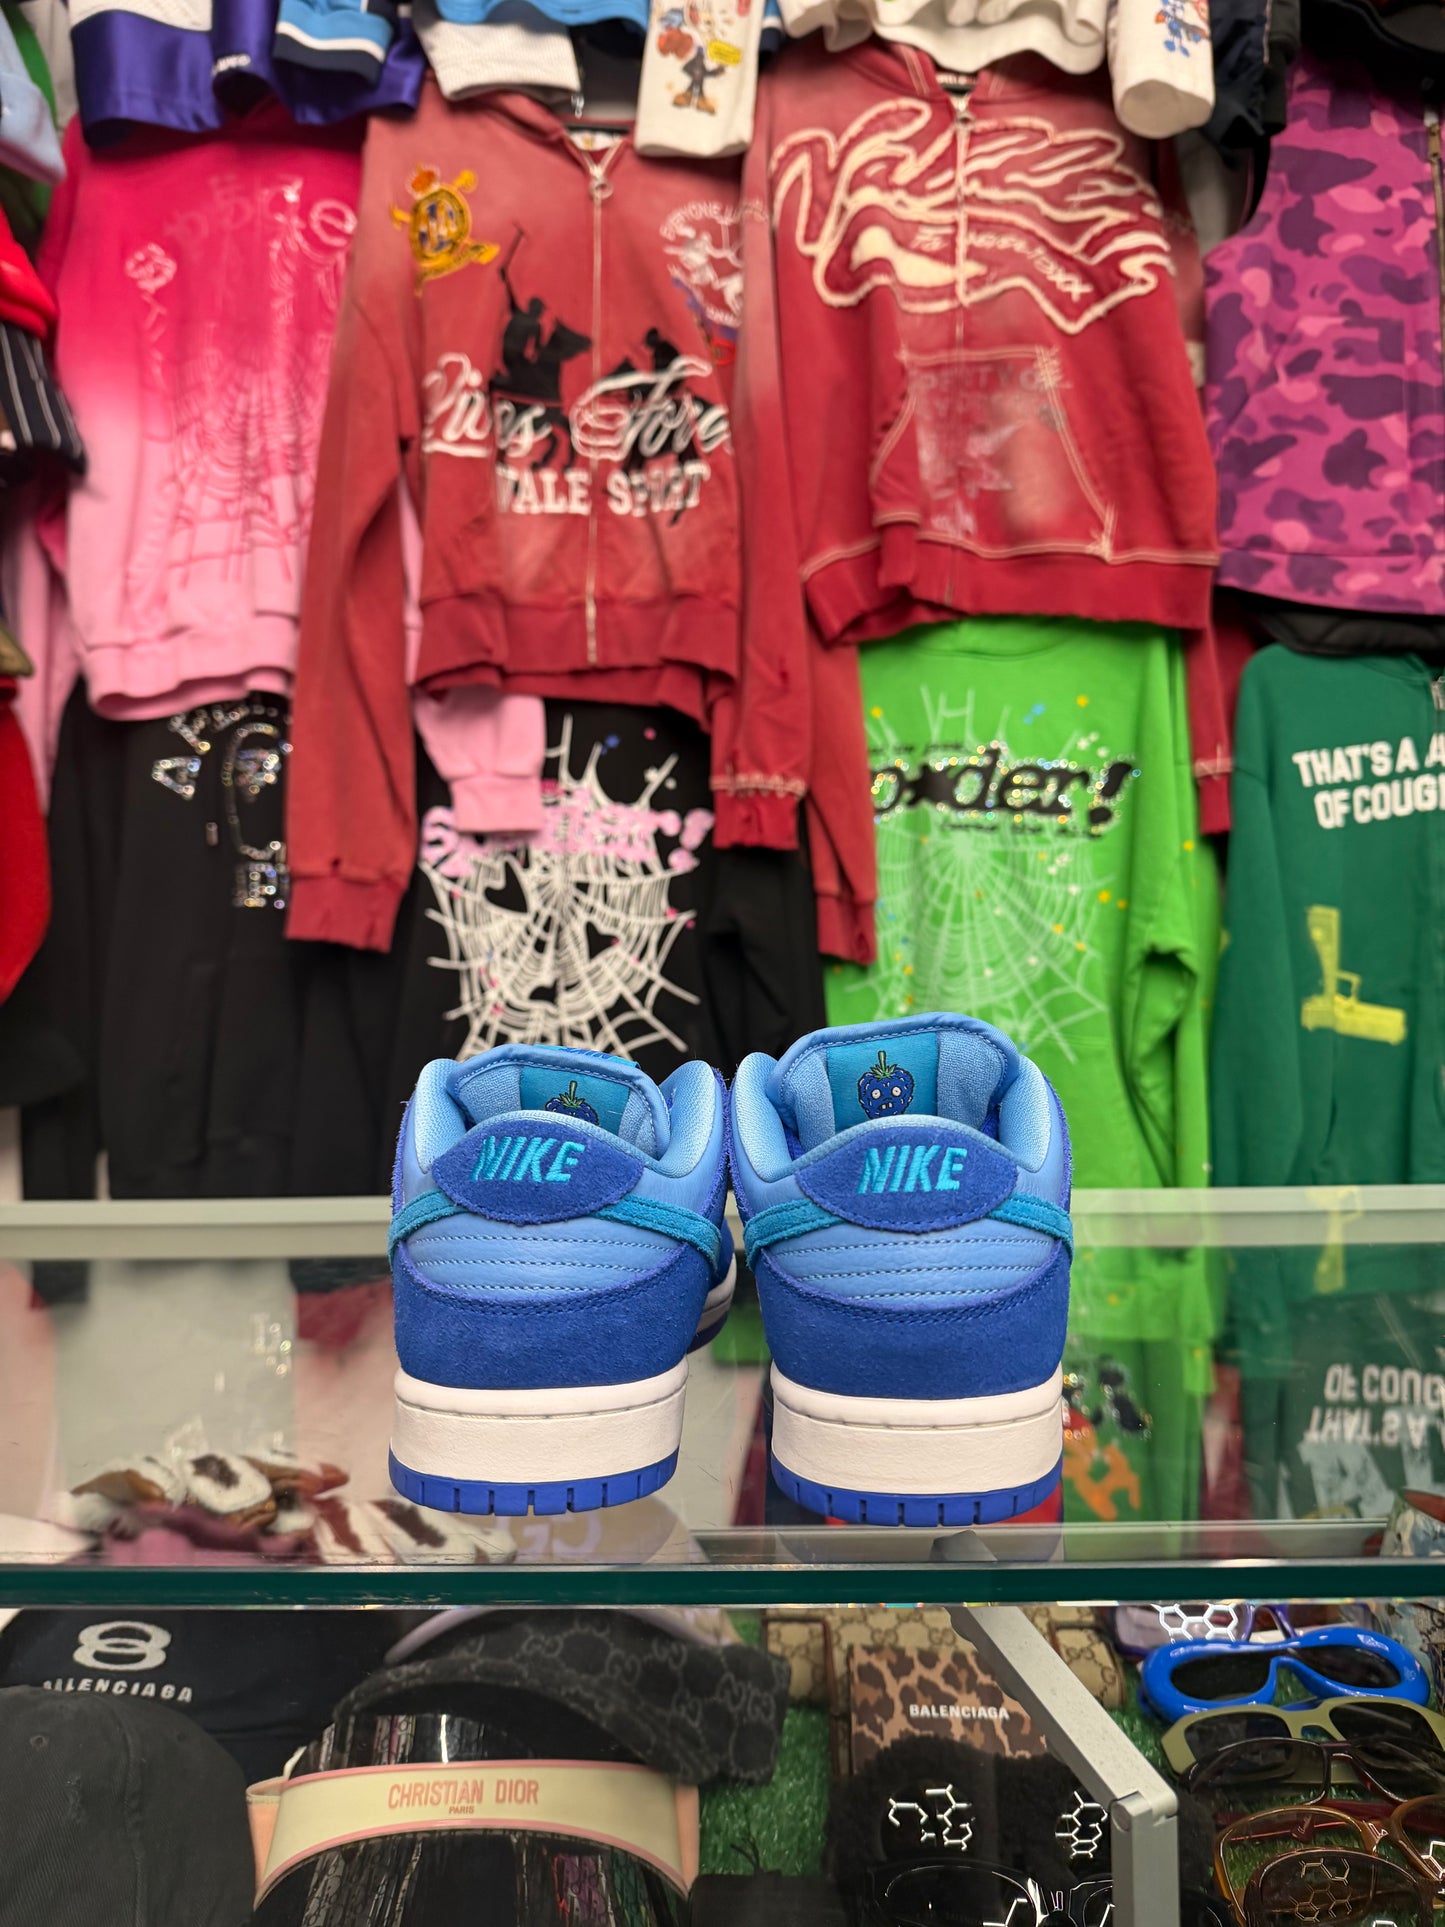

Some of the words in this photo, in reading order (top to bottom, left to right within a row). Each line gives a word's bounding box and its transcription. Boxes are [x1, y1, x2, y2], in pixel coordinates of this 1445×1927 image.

[1291, 740, 1393, 788] THAT'S
[1395, 735, 1420, 773] A
[1314, 788, 1350, 830] OF
[1353, 773, 1445, 824] COUG
[469, 1135, 585, 1183] NIKE
[856, 1144, 968, 1194] NIKE
[908, 1703, 1010, 1721] BALENCIAGA
[387, 1779, 484, 1809] CHRISTIAN
[495, 1778, 540, 1805] DIOR
[448, 1805, 475, 1814] PARIS
